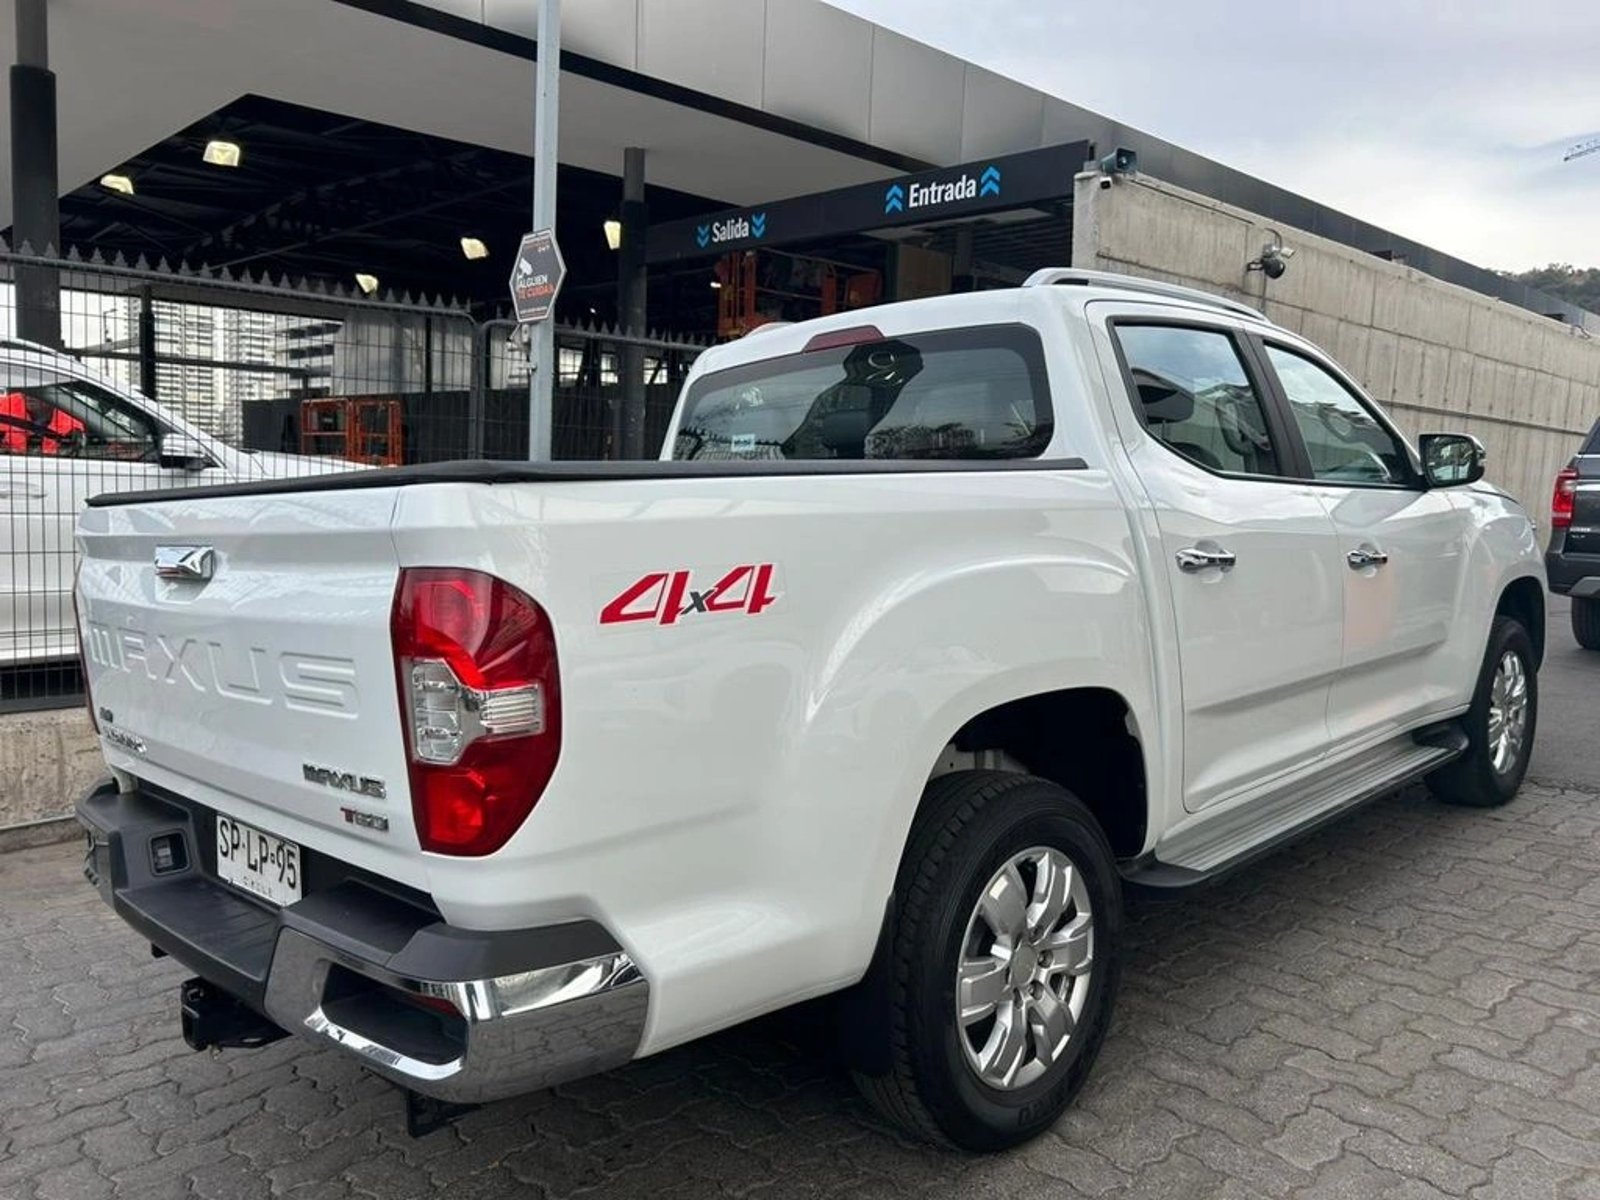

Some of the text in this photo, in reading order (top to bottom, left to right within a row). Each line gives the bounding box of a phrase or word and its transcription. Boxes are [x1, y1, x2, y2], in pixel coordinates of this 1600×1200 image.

[908, 174, 976, 208] Entrada
[711, 212, 749, 243] Salida
[88, 620, 359, 719] MAXUS
